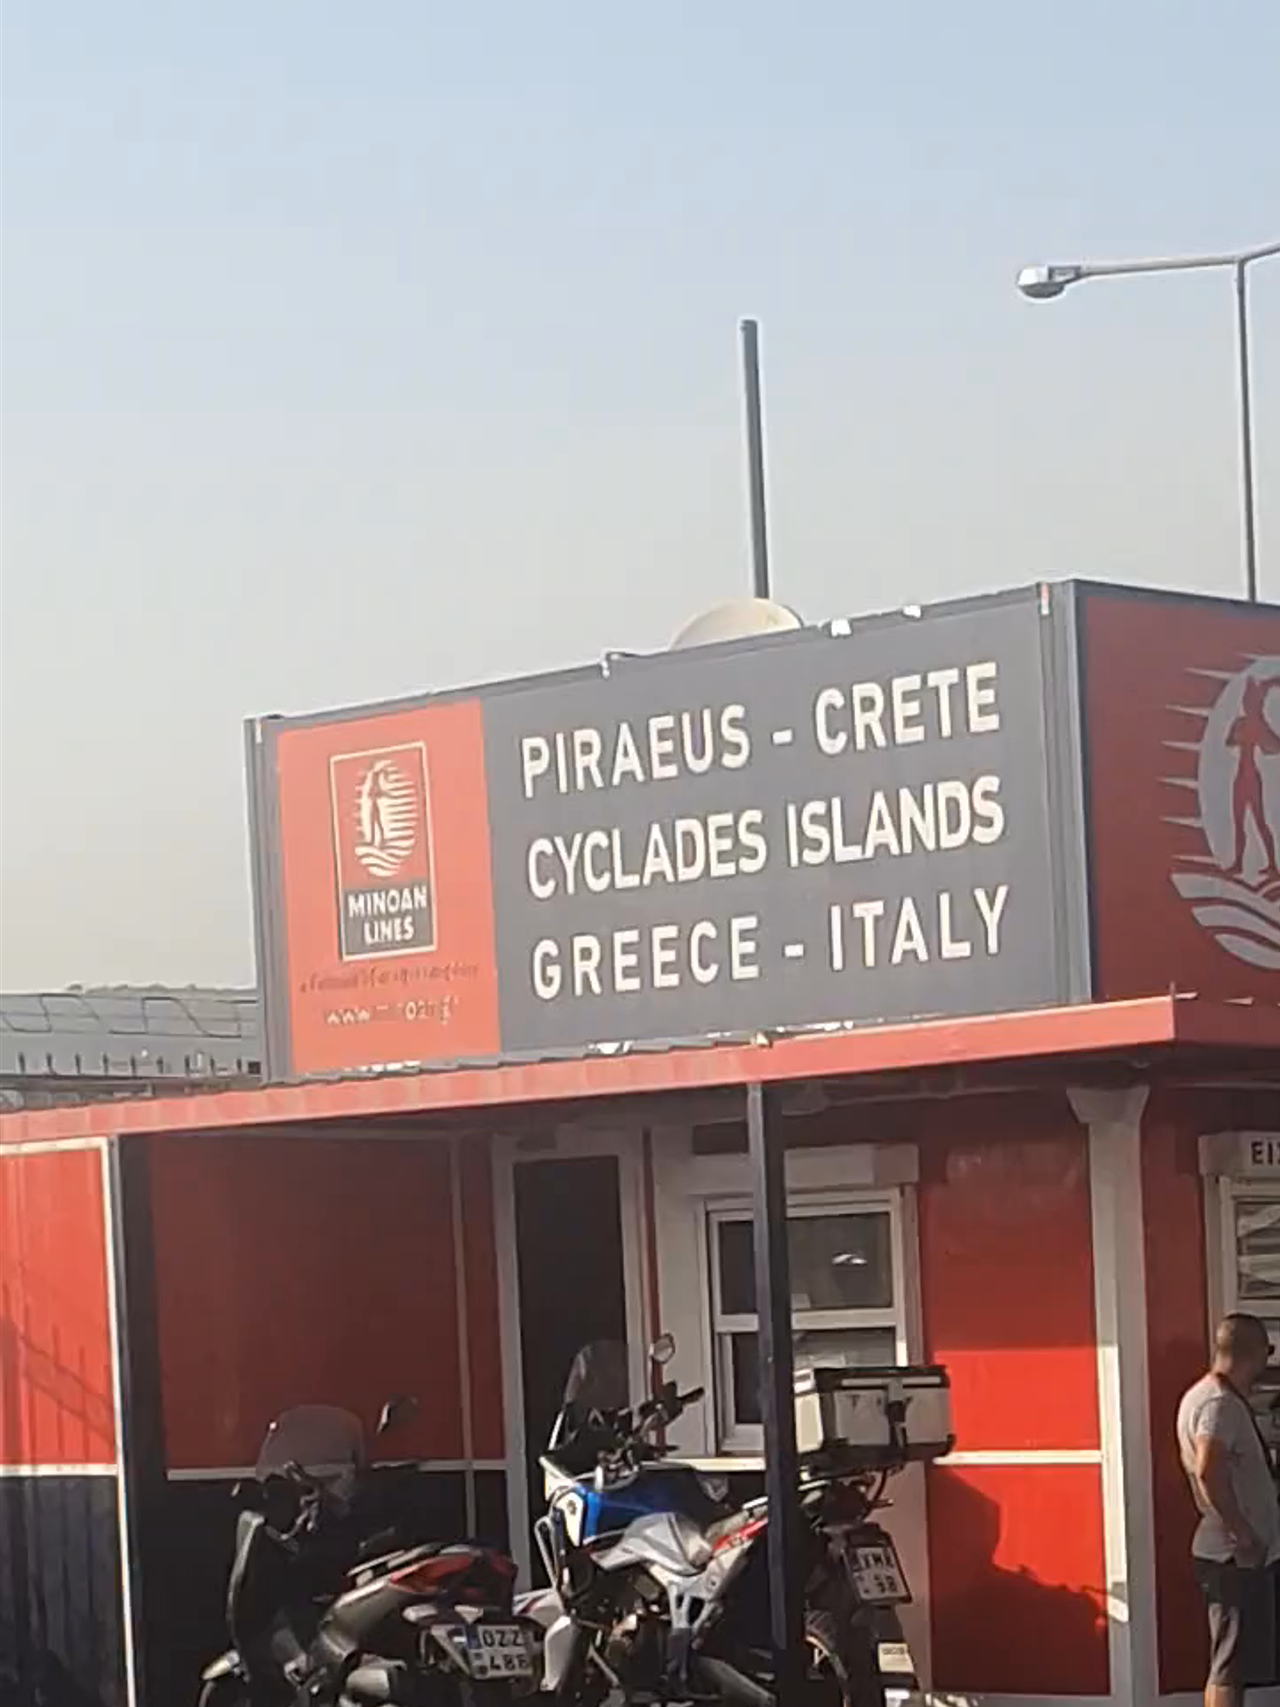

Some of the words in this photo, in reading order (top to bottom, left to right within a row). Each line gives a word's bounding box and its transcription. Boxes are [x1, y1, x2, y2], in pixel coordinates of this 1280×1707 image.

[521, 703, 751, 799] PIRAEUS
[815, 661, 1000, 755] CRETE
[528, 809, 768, 899] CYCLADES
[787, 774, 1005, 868] ISLANDS
[347, 885, 428, 918] MINOAN
[363, 915, 415, 945] LINES
[533, 914, 760, 1000] GREECE
[830, 884, 1009, 971] ITALY
[482, 1629, 524, 1647] OZZ
